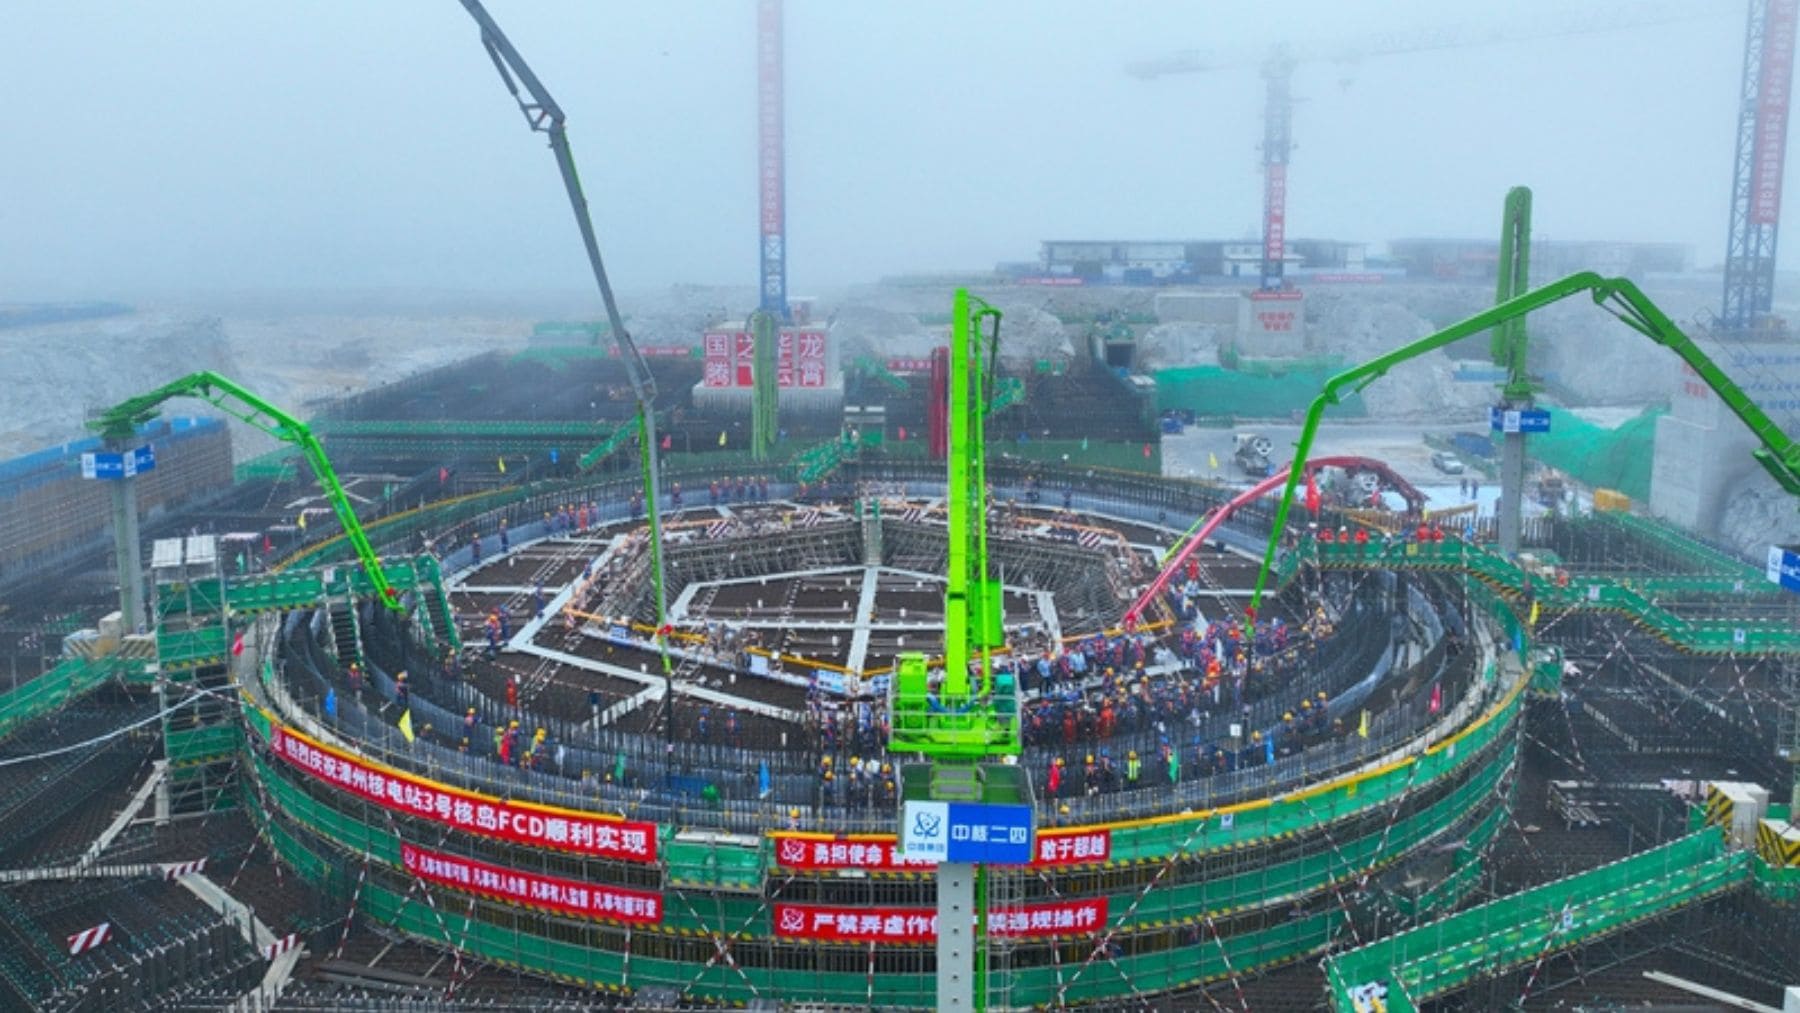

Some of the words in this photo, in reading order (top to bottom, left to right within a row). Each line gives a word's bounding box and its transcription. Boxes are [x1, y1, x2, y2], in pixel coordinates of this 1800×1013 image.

[812, 912, 938, 935] 严禁弄虚作
[972, 906, 1097, 931] 禁违规操作
